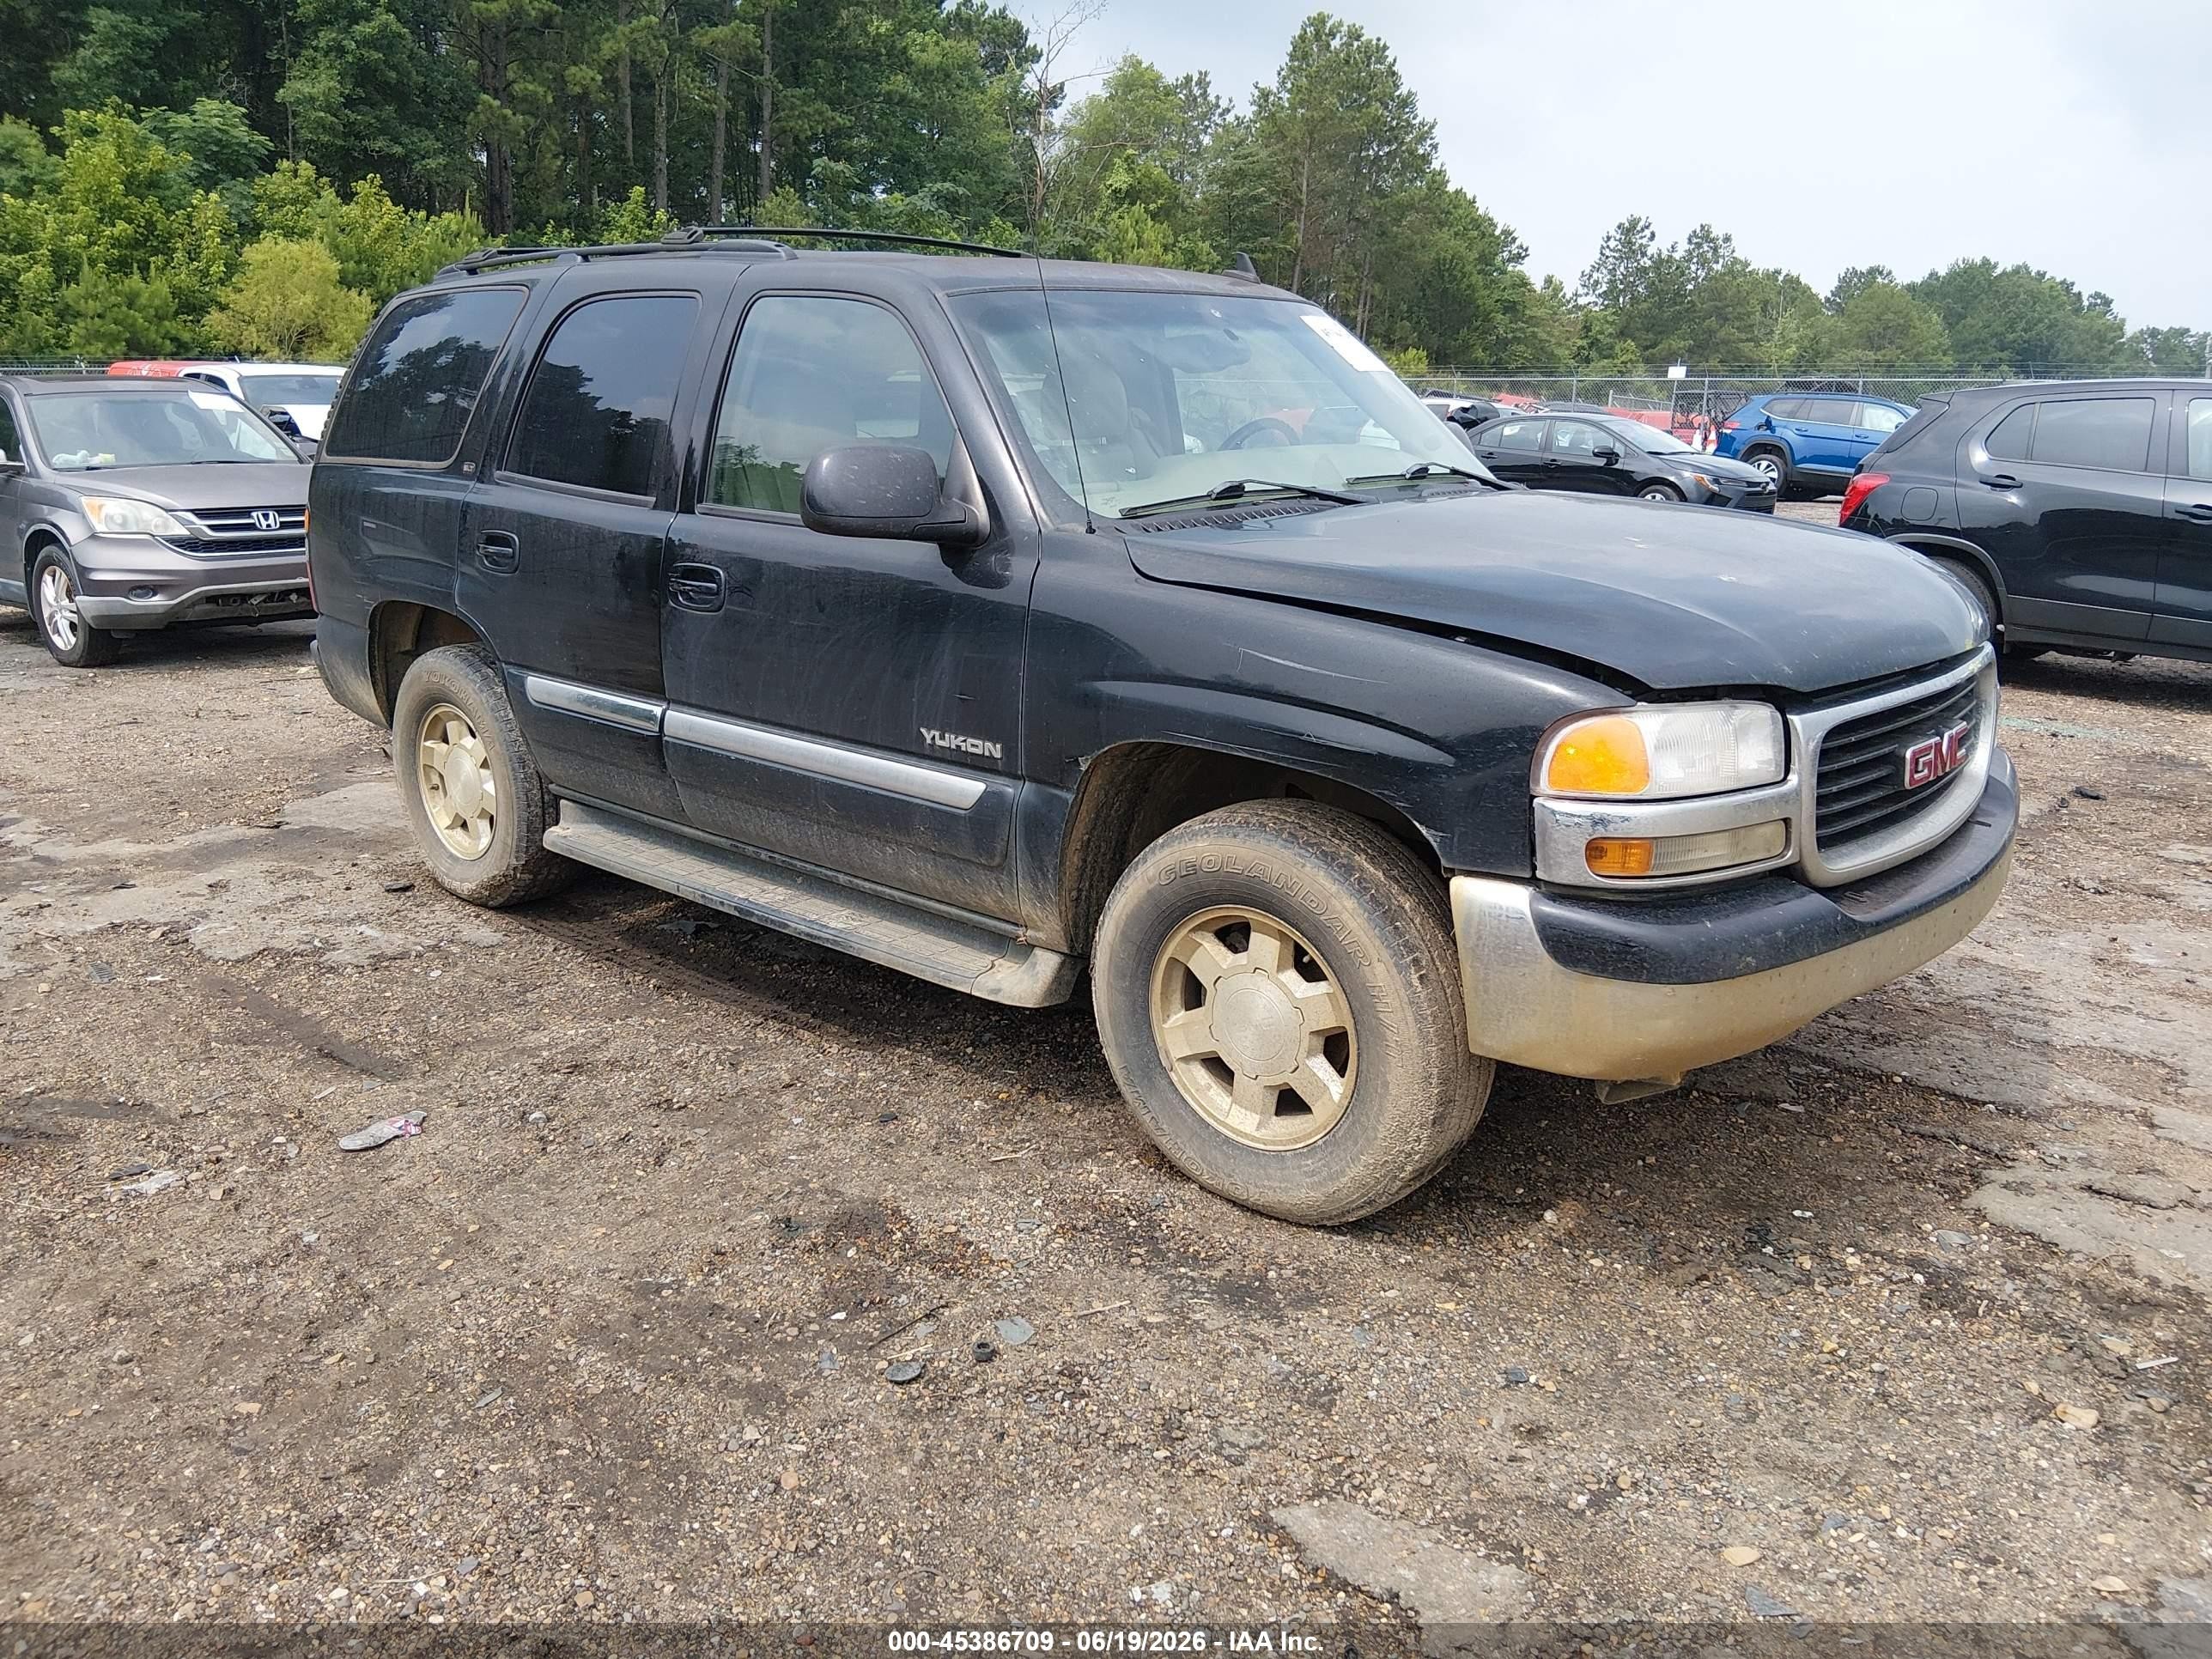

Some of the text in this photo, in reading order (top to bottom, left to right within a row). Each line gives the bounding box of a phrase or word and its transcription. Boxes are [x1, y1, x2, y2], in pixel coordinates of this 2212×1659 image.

[920, 727, 1003, 759] YUKON
[1905, 720, 1969, 790] GMC
[1158, 853, 1372, 969] GEOLANDAR
